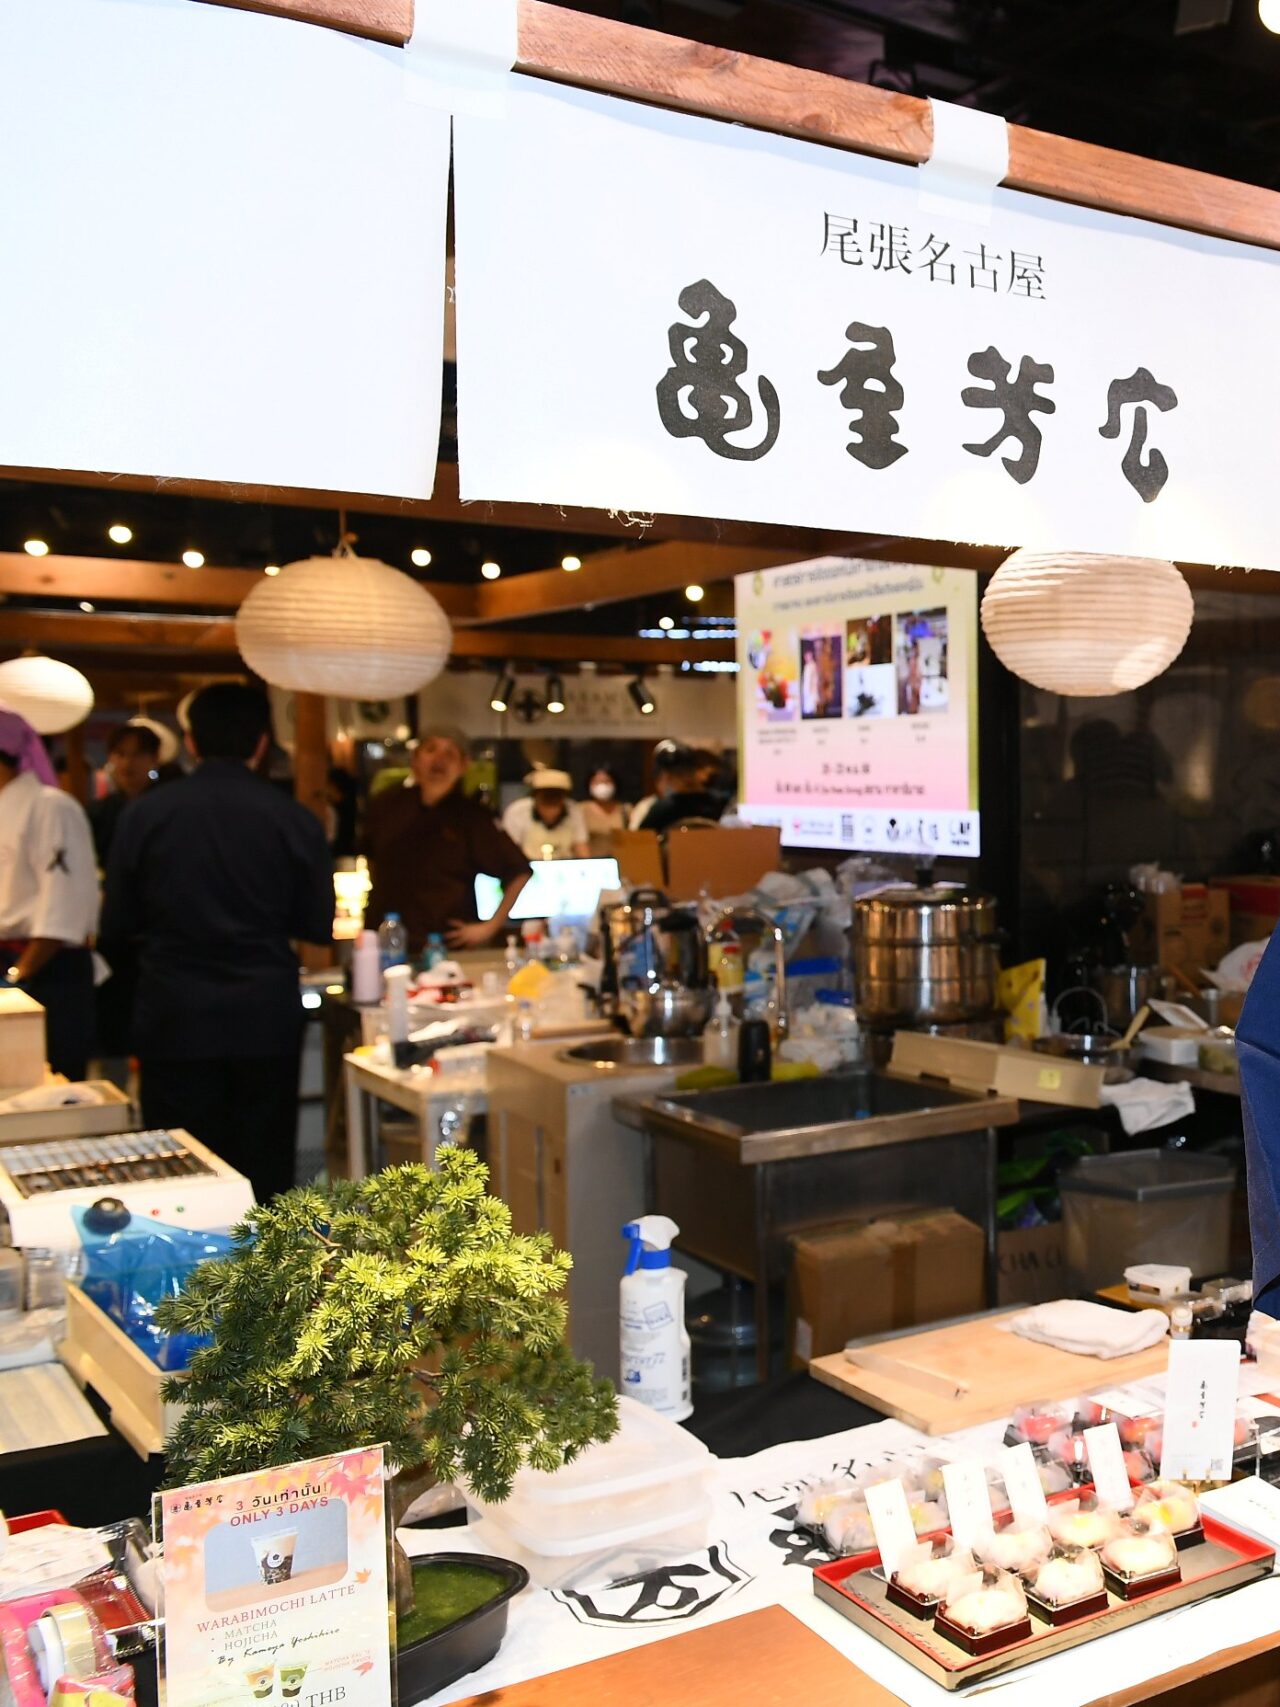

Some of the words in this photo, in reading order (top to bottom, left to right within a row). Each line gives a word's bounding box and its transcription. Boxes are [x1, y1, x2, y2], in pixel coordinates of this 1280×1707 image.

[819, 211, 1047, 300] 尾張名古屋
[230, 1509, 270, 1527] ONLY
[276, 1506, 284, 1517] 3
[289, 1496, 329, 1514] DAYS
[236, 1501, 244, 1511] 3
[196, 1597, 305, 1633] WARABIMOCHI
[310, 1584, 355, 1605] LATTE
[224, 1619, 278, 1640] MATCHA
[224, 1631, 279, 1651] HOJICHA
[217, 1655, 234, 1667] By
[305, 1686, 346, 1707] THB
